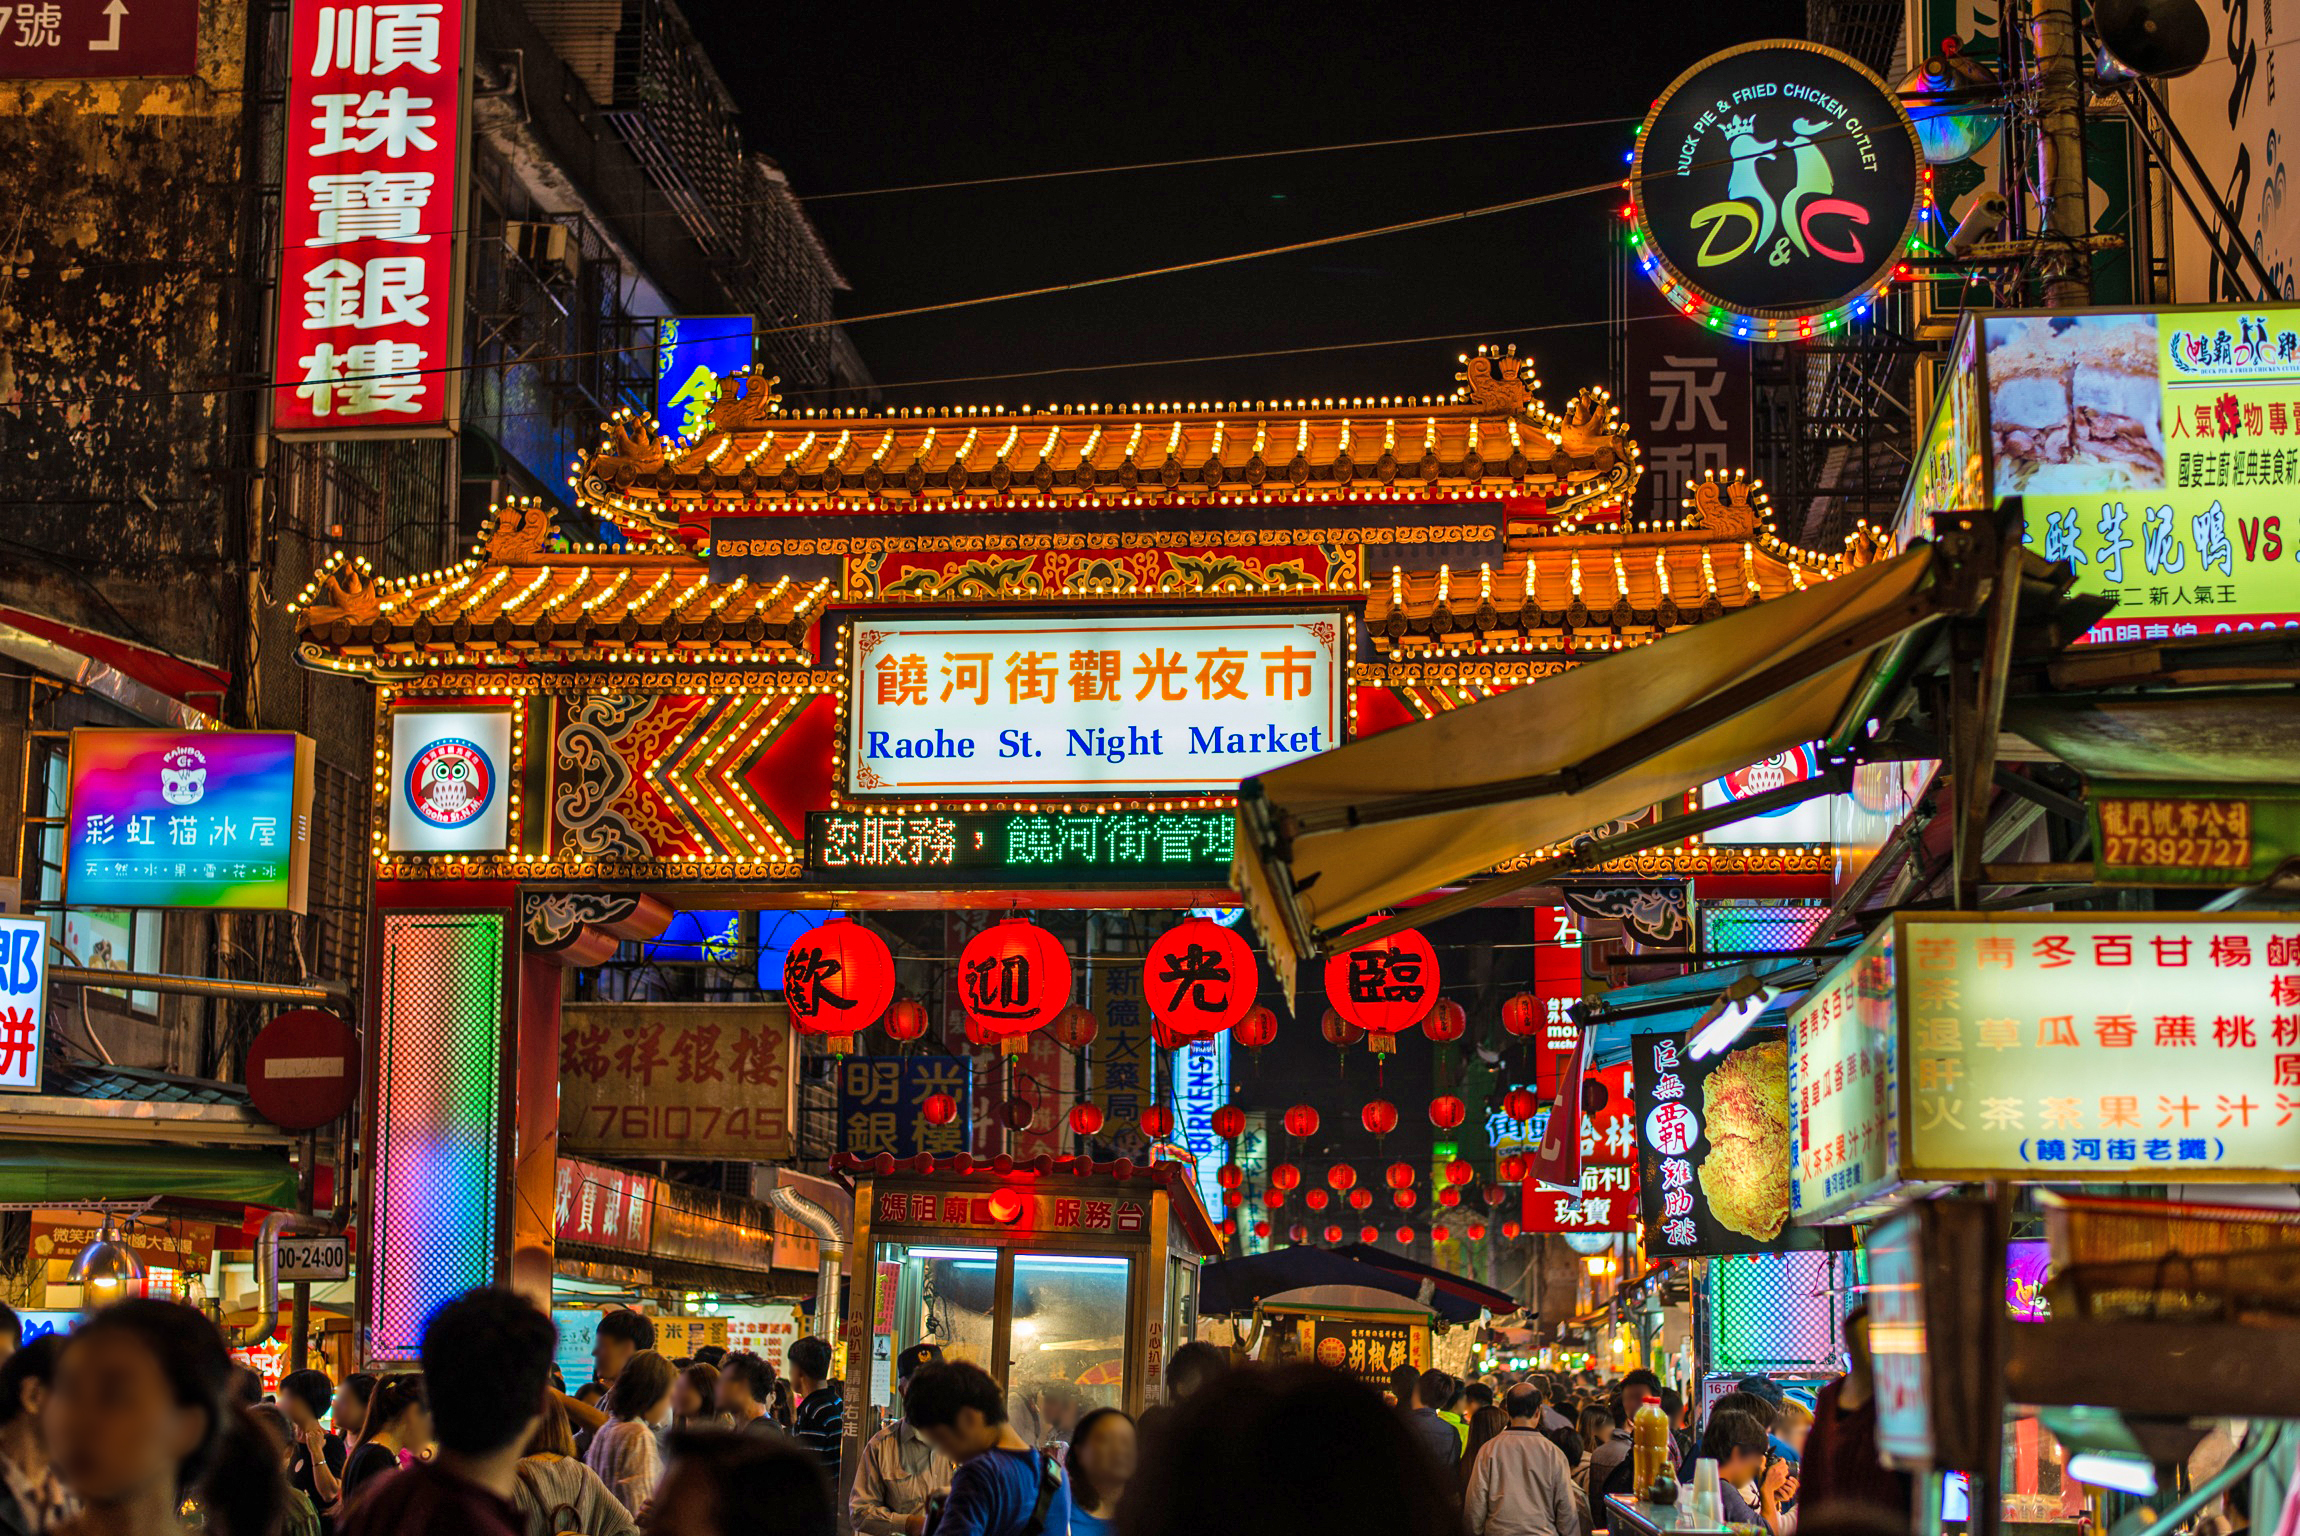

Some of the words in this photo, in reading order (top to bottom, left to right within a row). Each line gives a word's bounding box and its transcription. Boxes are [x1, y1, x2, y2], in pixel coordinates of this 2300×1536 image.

[1677, 135, 1699, 176] DUCK
[1694, 110, 1718, 133] PIE
[1716, 100, 1731, 113] &
[1732, 83, 1777, 104] FRIED
[1783, 83, 1847, 119] CHICKEN
[1846, 118, 1877, 172] CUTLET
[296, 3, 443, 416] 順珠寶銀樓
[1769, 237, 1791, 266] &
[2178, 448, 2300, 488] 國宴主廚經典美食新
[2022, 499, 2233, 583] 酥芋泥鴨
[2239, 516, 2283, 562] VS
[874, 645, 1317, 707] 饒河街觀光夜市
[867, 730, 975, 759] Raohe
[998, 729, 1042, 757] St.
[1066, 728, 1163, 764] Night
[1189, 724, 1322, 755] Market
[420, 802, 449, 822] Raohe
[2107, 838, 2248, 867] 27392727
[785, 947, 858, 1018] 歡
[965, 955, 1041, 1019] 迎
[1159, 943, 1231, 1012] 光
[1348, 947, 1426, 1003] 臨
[560, 1022, 784, 1087] 瑞祥銀樓
[1105, 966, 1142, 1123] 新德大藥局
[847, 1062, 964, 1105] 明光
[1054, 1198, 1145, 1231] 服務台
[849, 1310, 863, 1365] 小心扒手
[1148, 1322, 1162, 1377] 小心扒手
